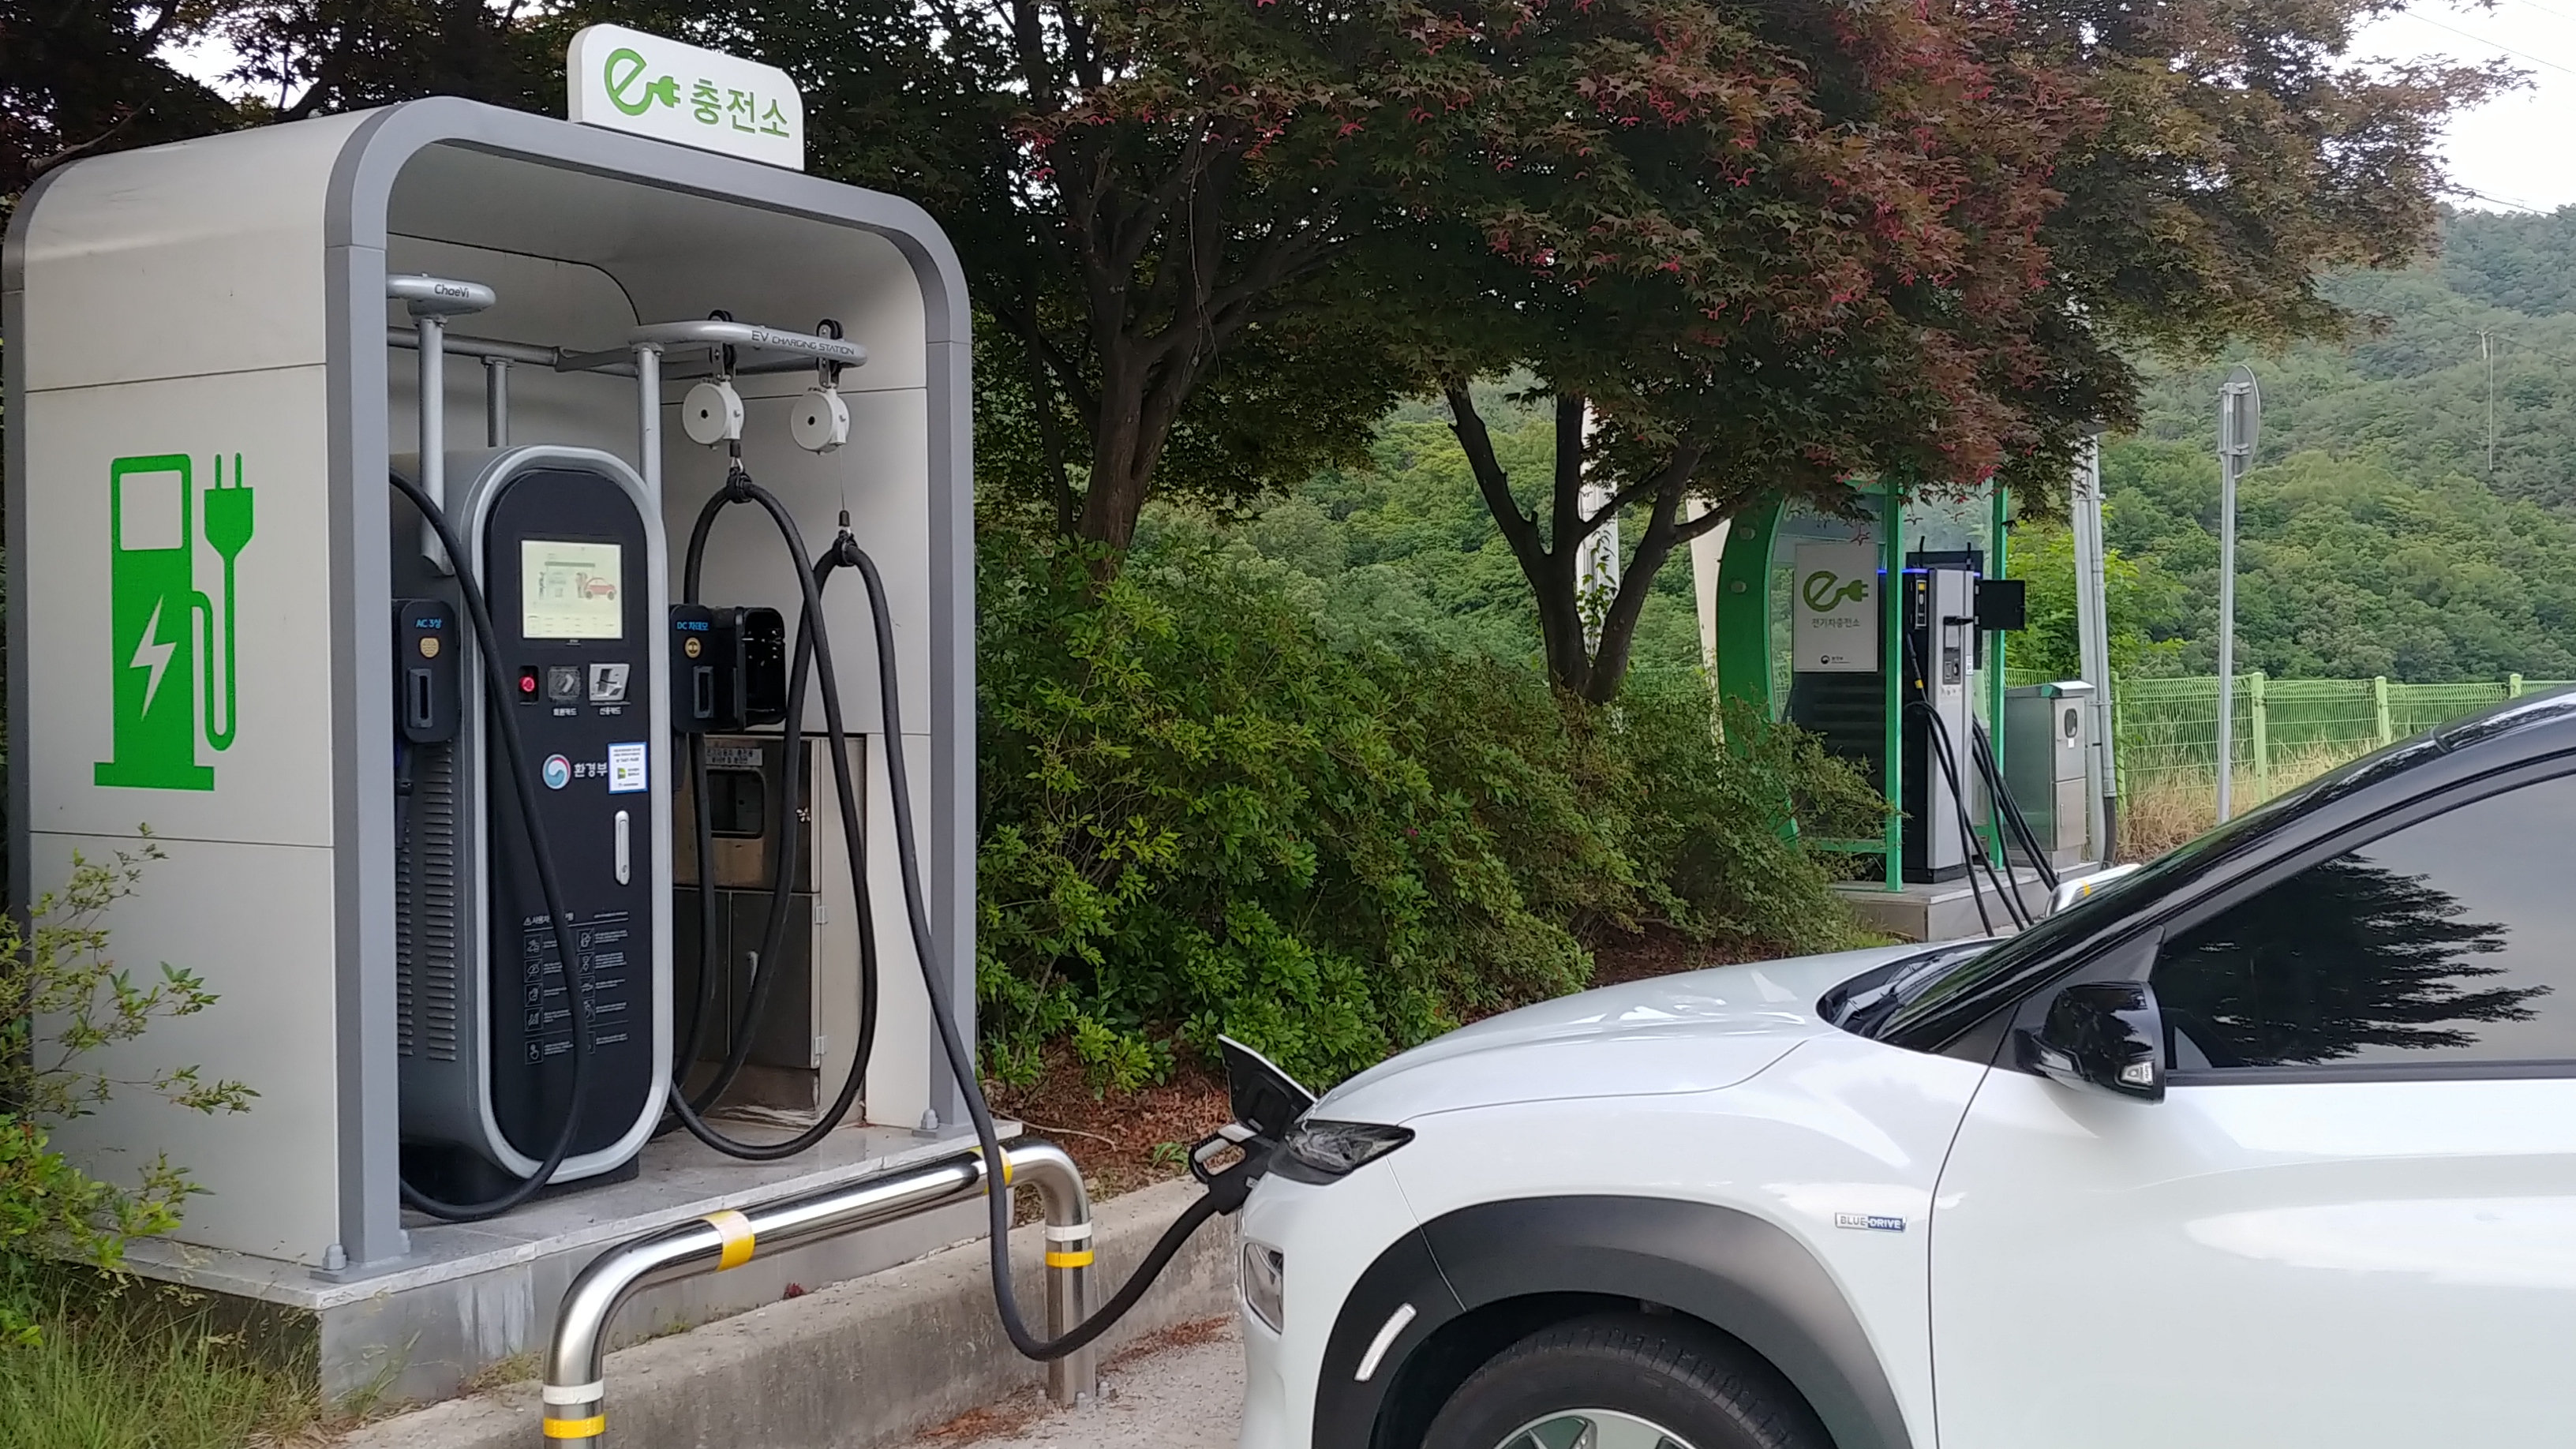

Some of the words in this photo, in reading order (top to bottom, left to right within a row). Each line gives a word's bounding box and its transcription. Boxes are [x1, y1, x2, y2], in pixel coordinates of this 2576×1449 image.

[690, 77, 790, 139] 충전소
[434, 283, 470, 298] ChaeVi
[751, 330, 769, 342] EV
[771, 335, 817, 350] CHARGING
[818, 343, 855, 355] STATION
[416, 619, 428, 628] AC
[429, 618, 443, 629] 3상
[676, 621, 687, 631] DC
[1811, 617, 1860, 628] 전기차충전소
[574, 762, 607, 777] 환경부
[1840, 1215, 1867, 1226] BLUE
[1869, 1219, 1901, 1230] DRIVE
